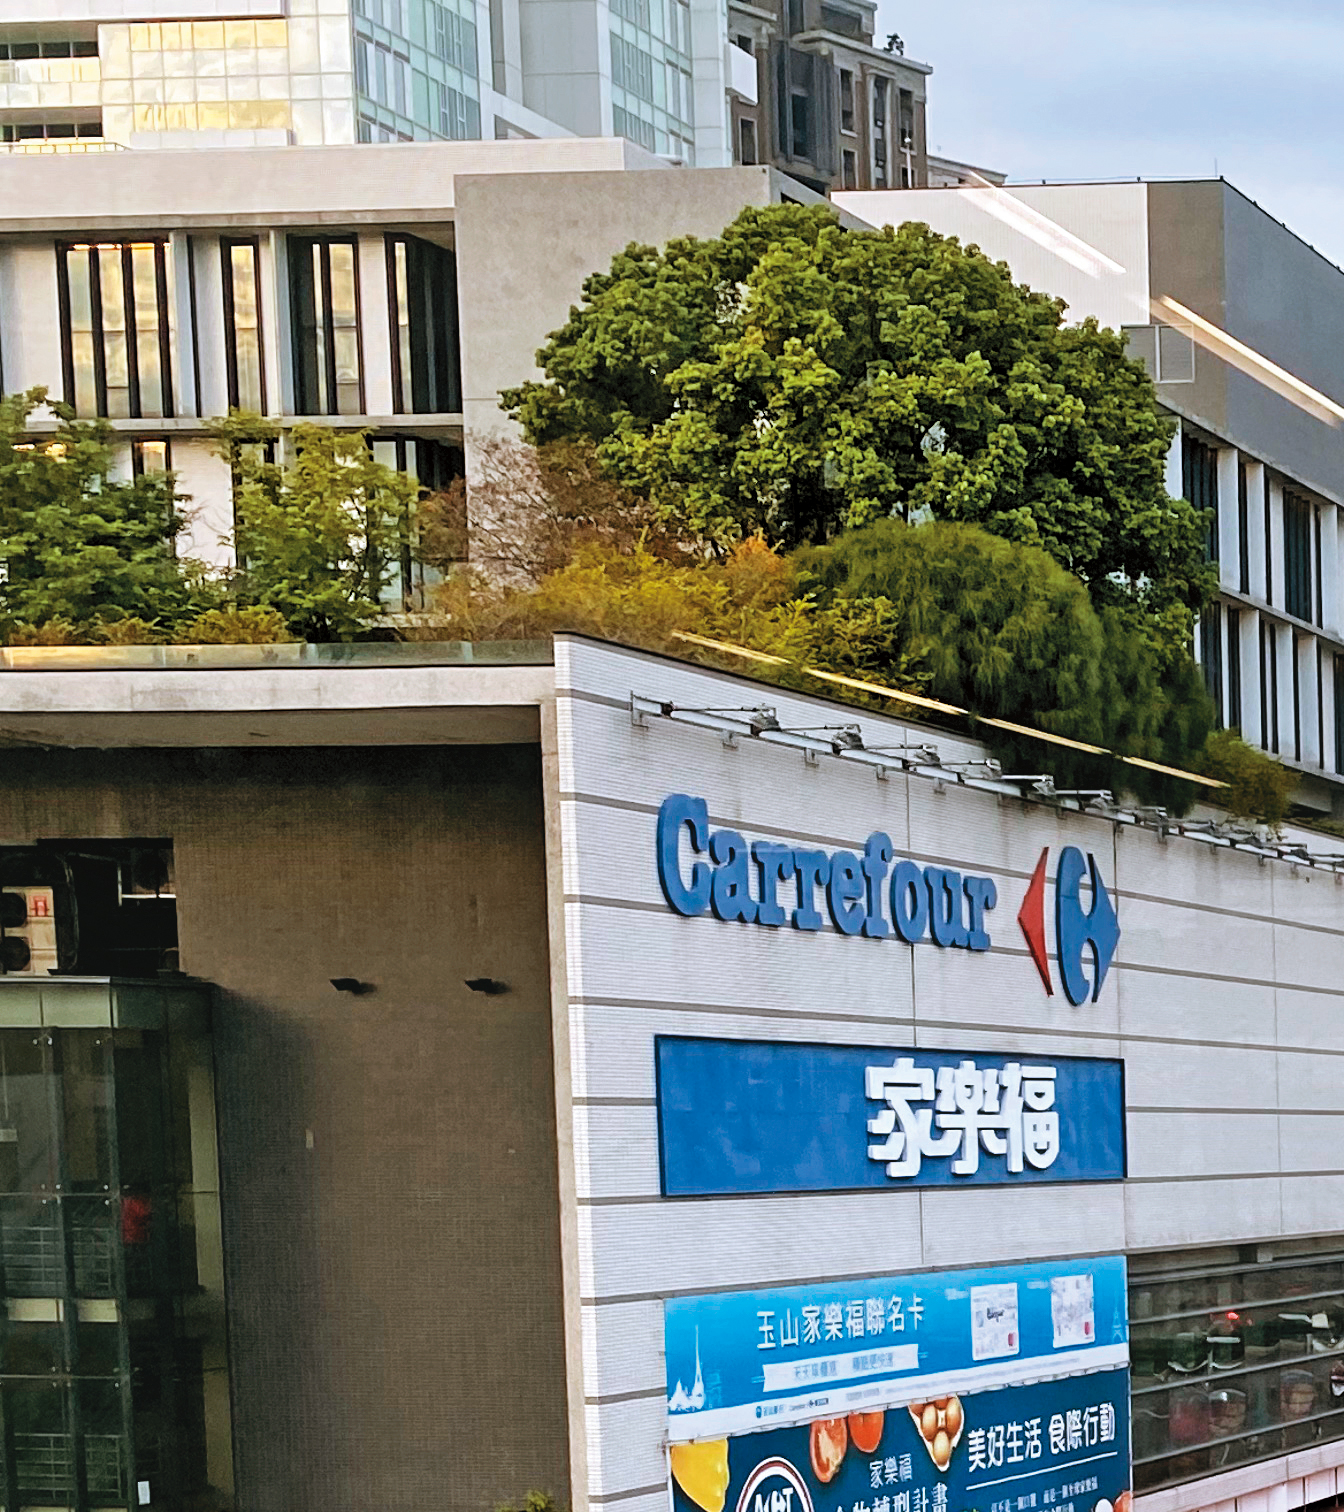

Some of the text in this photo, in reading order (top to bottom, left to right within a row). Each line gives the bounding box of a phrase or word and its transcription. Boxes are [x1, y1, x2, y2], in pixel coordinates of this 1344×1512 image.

[657, 794, 997, 952] Carrefour
[865, 1057, 1060, 1178] 家樂福
[756, 1292, 924, 1350] 玉山家樂福聯名卡
[870, 1453, 913, 1489] 家樂福
[967, 1402, 1116, 1473] 美好生活 食際行動
